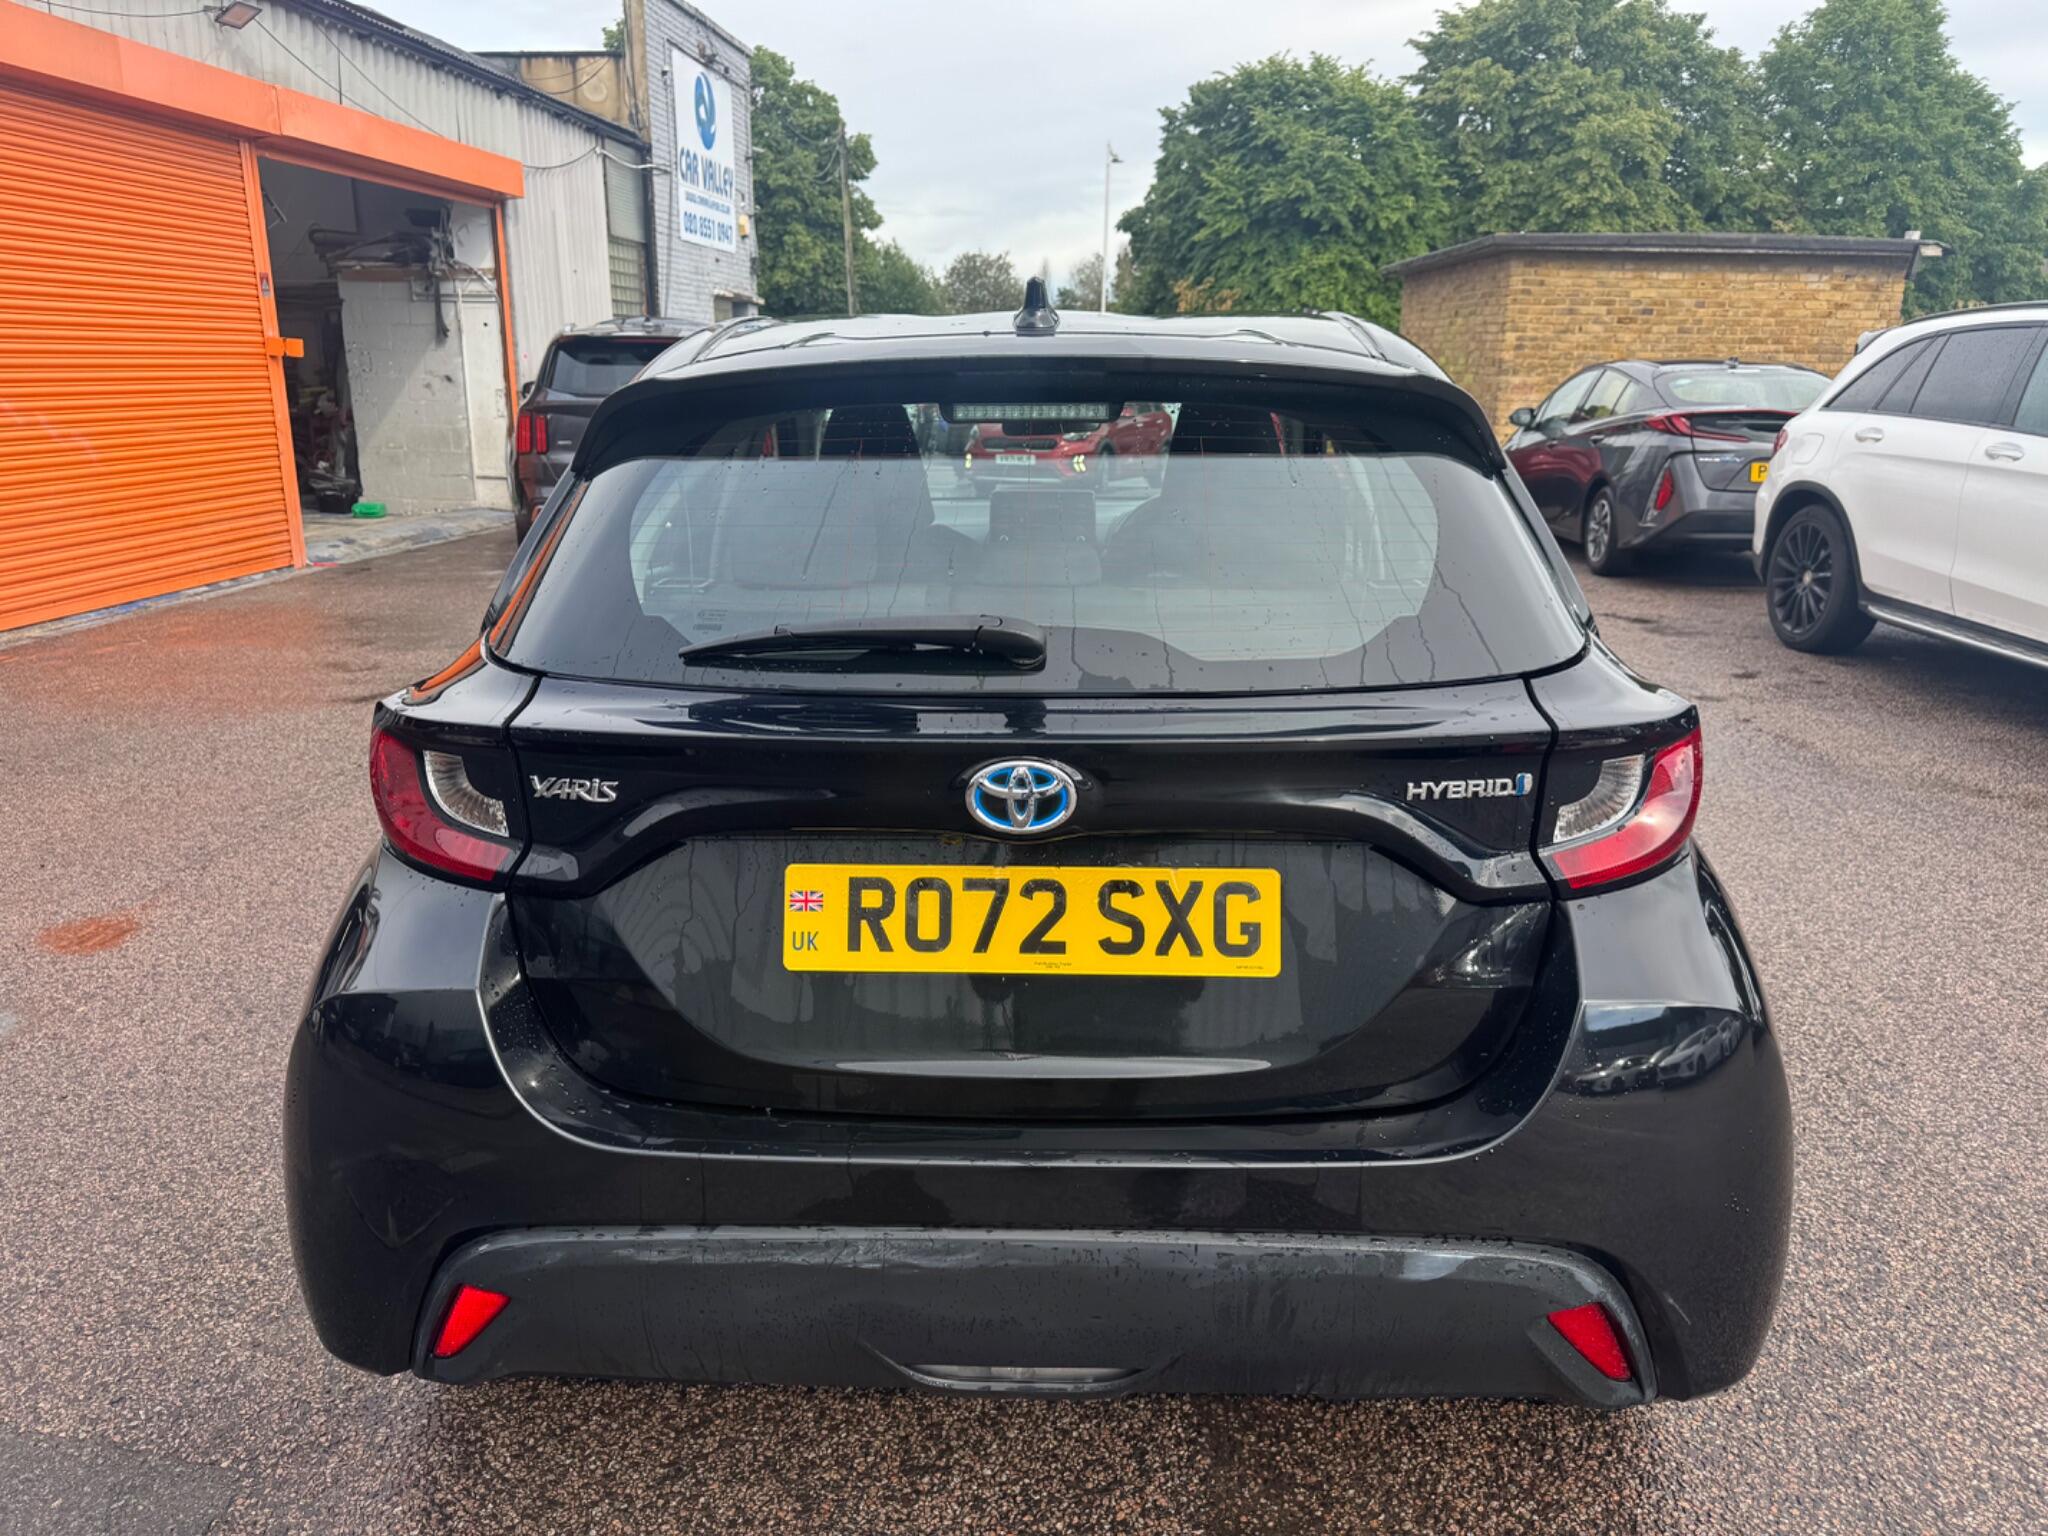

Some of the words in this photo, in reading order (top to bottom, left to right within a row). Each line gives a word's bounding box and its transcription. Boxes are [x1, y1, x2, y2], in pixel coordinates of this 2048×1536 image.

[680, 146, 699, 187] CAR
[701, 155, 733, 199] VALLEY
[684, 211, 697, 234] 020
[529, 775, 619, 802] YARIS
[1407, 778, 1514, 801] HYBRID
[1098, 879, 1262, 957] SXG
[792, 931, 819, 951] UK
